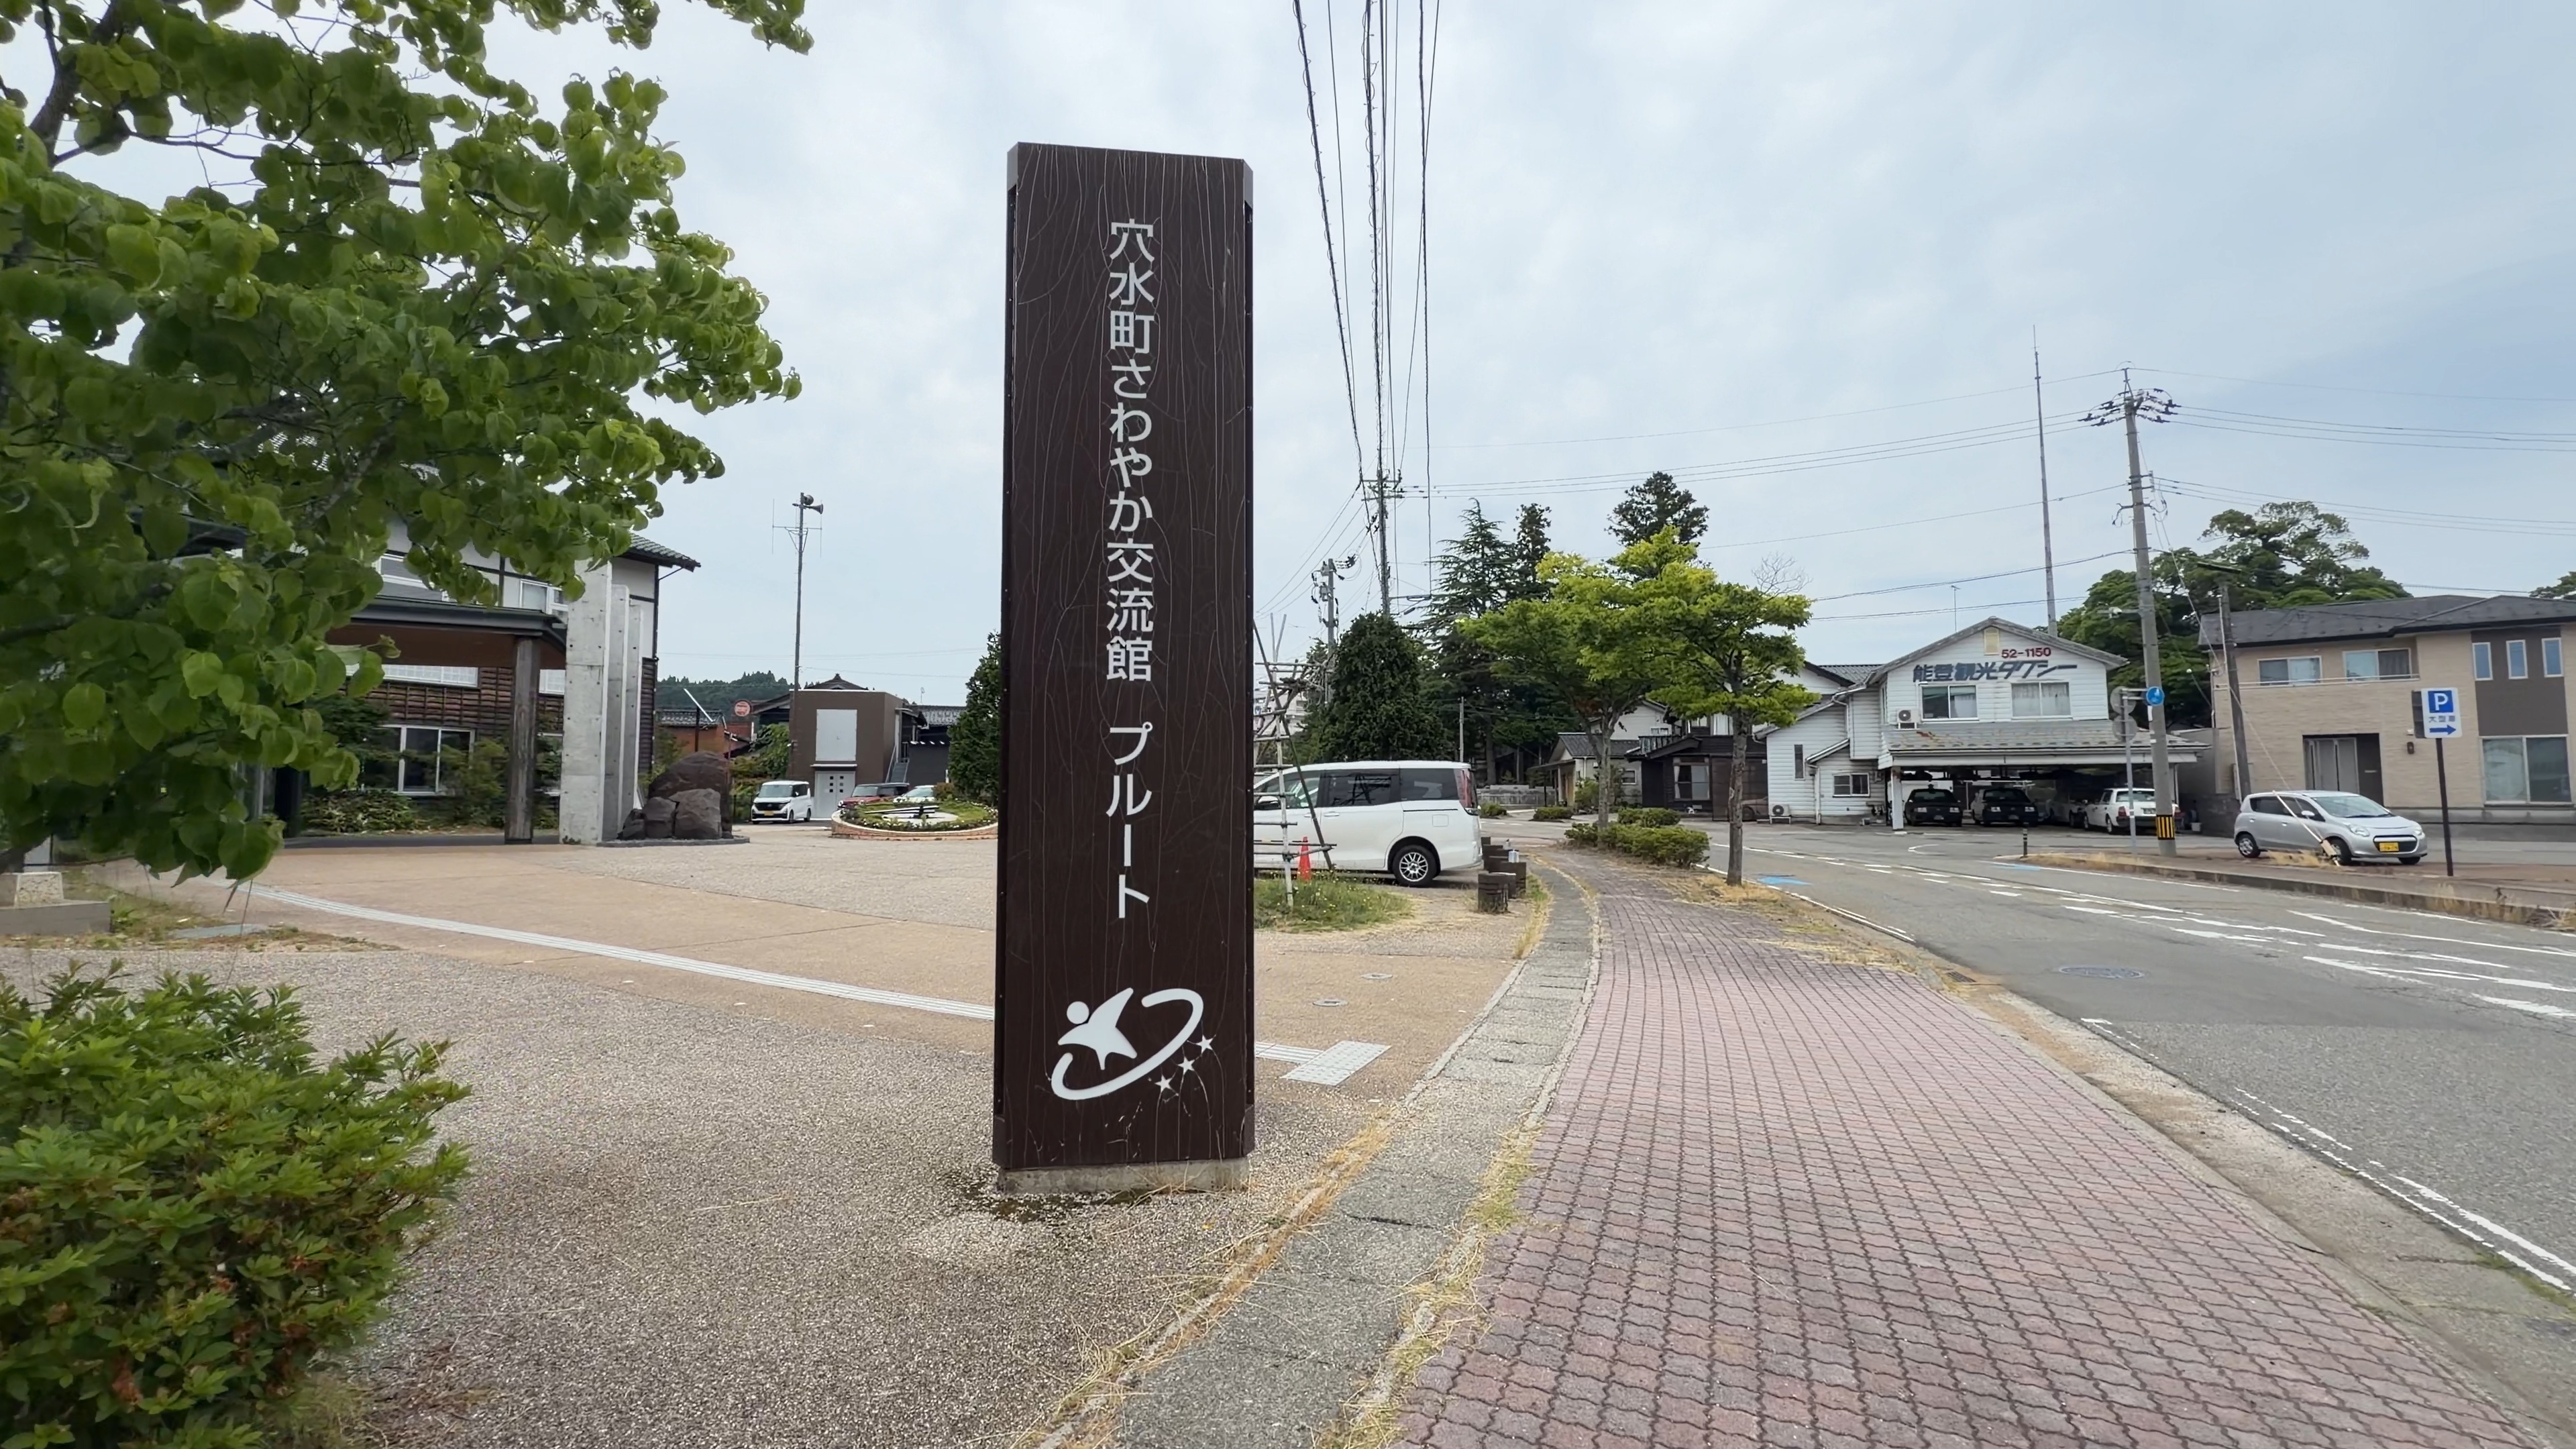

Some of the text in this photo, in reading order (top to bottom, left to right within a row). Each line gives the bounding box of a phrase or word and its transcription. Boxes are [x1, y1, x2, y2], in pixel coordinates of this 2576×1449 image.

[1106, 218, 1155, 919] 穴水町さわやか交流館 プルート
[2001, 647, 2051, 659] 52-1150
[1913, 659, 2078, 682] 能登観光タクシー
[2433, 692, 2449, 711] P
